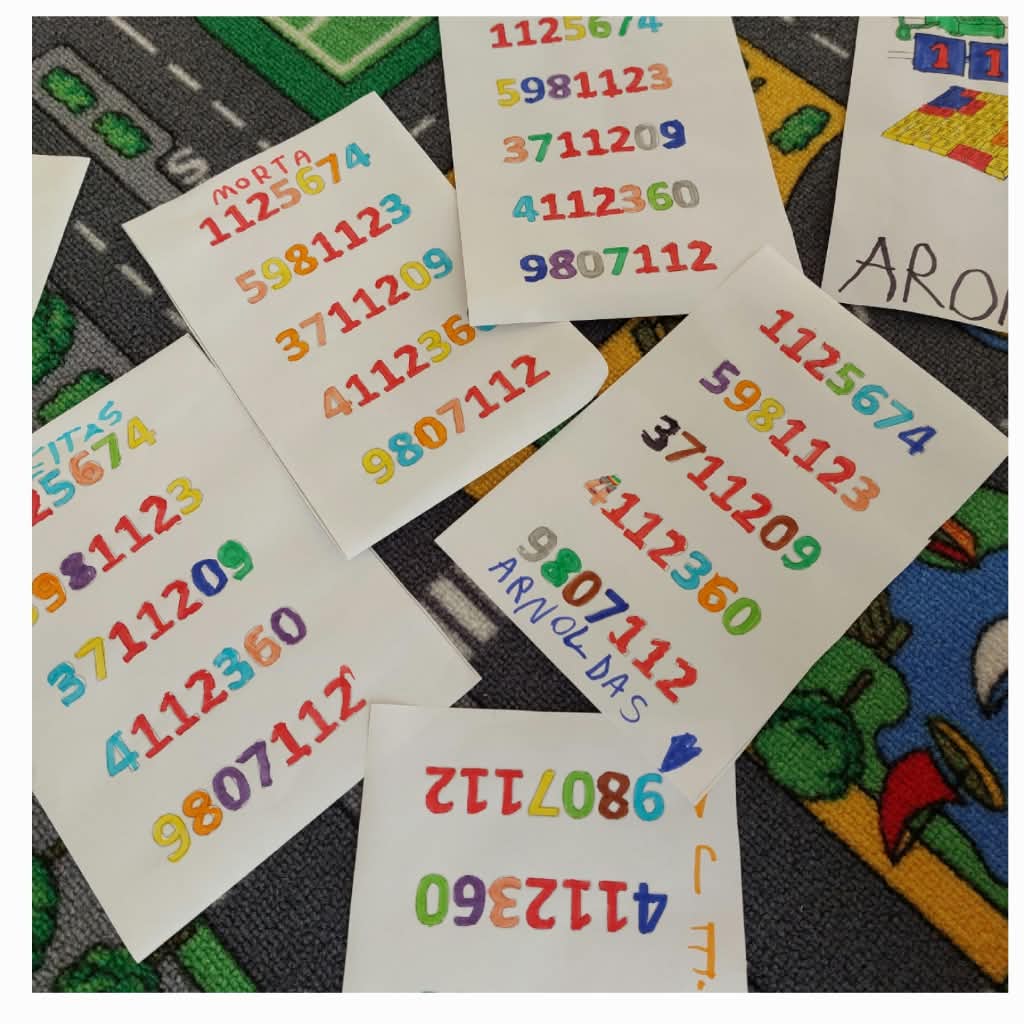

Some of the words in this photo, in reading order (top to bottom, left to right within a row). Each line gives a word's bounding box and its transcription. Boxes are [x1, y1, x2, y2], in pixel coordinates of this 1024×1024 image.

[495, 63, 673, 110] 5981123
[503, 119, 686, 163] 3711209
[199, 141, 371, 247] 1125674
[212, 149, 312, 205] MORTA
[512, 179, 700, 223] 4112360
[235, 193, 411, 305] 5981123
[275, 247, 454, 362] 3711209
[519, 240, 718, 283] 9807112
[838, 236, 1008, 325] ARO
[322, 314, 497, 419] 411236
[361, 354, 551, 485] 9807112
[759, 308, 937, 457] 1125674
[699, 359, 881, 513] 5981123
[641, 414, 822, 572] 3711209
[32, 477, 204, 625] 981123
[583, 474, 762, 637] 4112360
[47, 539, 255, 707] 3711209
[516, 525, 698, 704] 9807112
[106, 607, 307, 778] 4112360
[152, 665, 368, 863] 9807112
[424, 765, 666, 822] 9807112
[415, 873, 669, 934] 4112360
